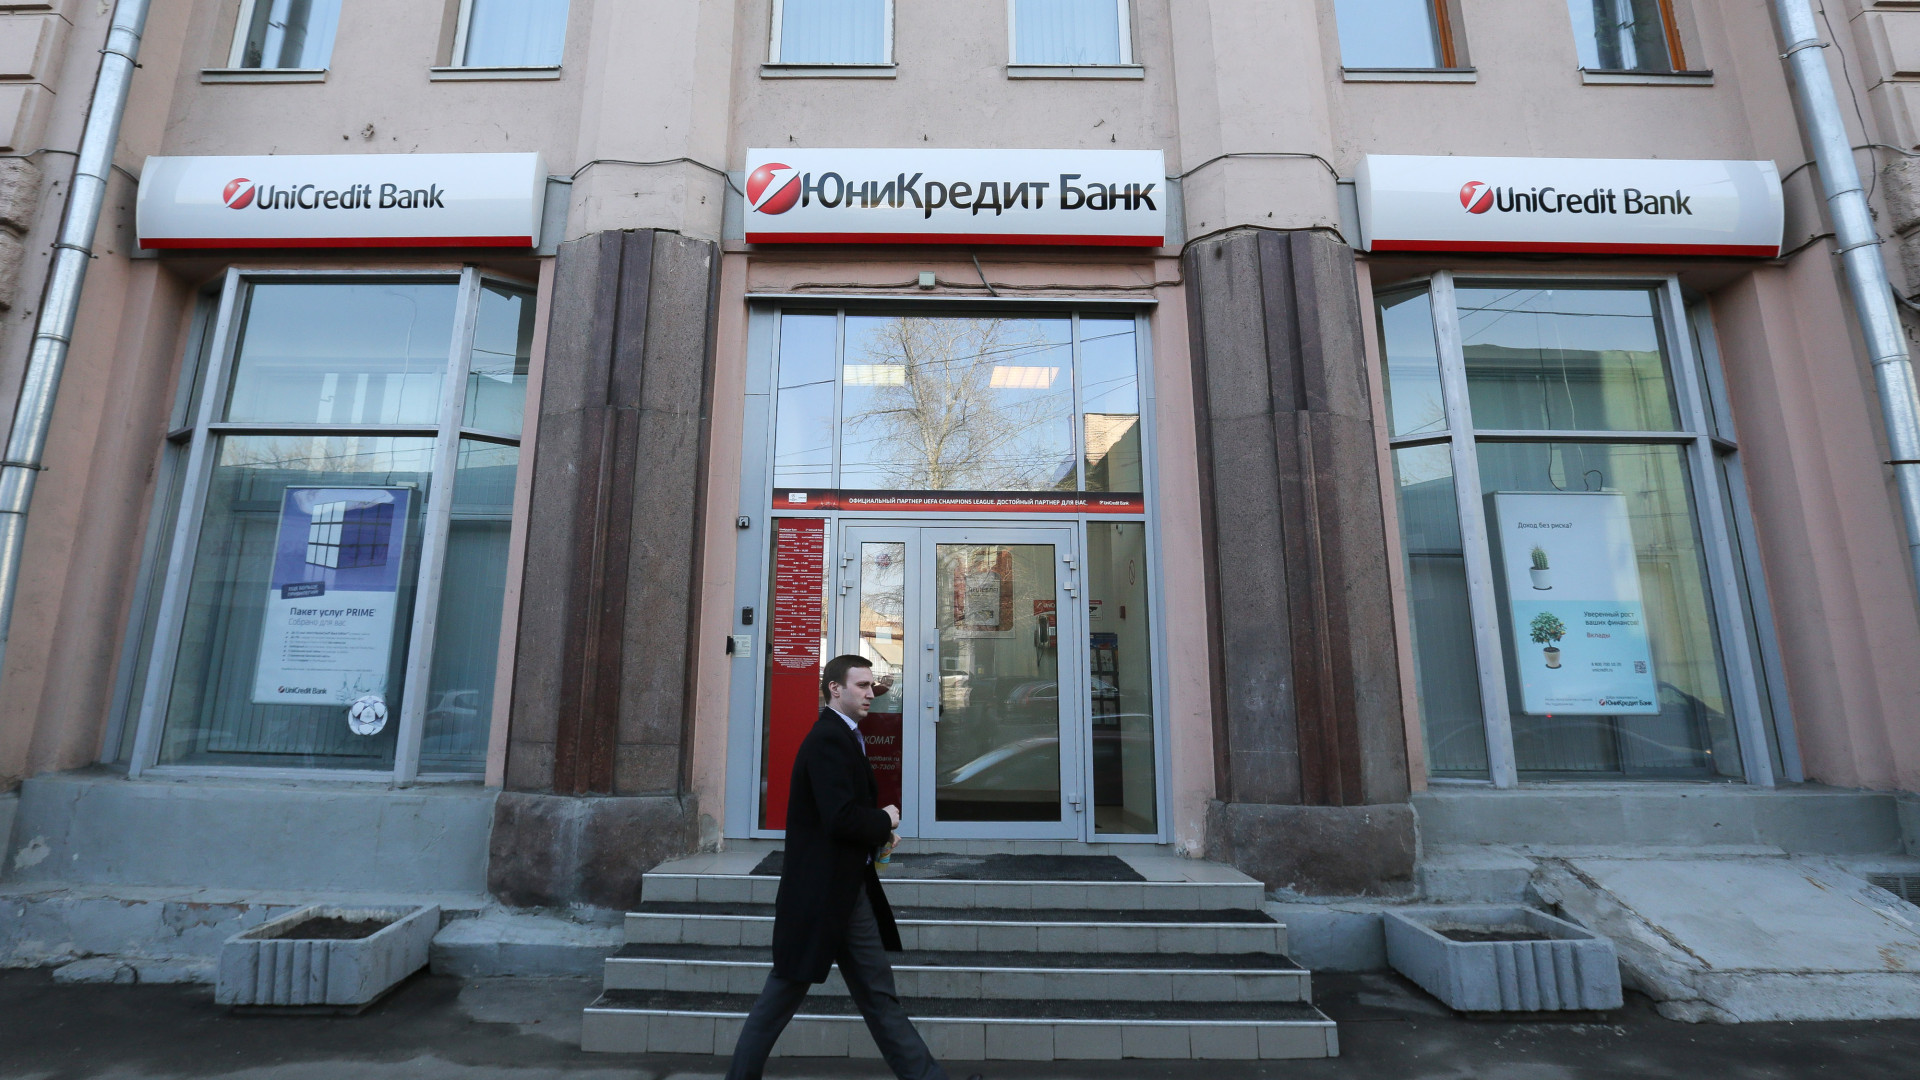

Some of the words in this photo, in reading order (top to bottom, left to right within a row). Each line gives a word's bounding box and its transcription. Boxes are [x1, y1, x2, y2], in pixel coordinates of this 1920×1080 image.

[256, 183, 372, 210] UniCredit
[378, 183, 445, 209] Bank
[801, 171, 1050, 219] ЮниКредит
[1059, 173, 1157, 211] Банк
[1495, 186, 1617, 214] UniCredit
[1623, 188, 1693, 215] Bank
[848, 497, 896, 505] ОФИЦИАЛЬНЫЙ
[996, 498, 1034, 506] ДОСТОЙНЫЙ
[1517, 521, 1538, 529] Доход
[1538, 521, 1550, 529] без
[1550, 522, 1573, 530] риска?
[290, 607, 317, 616] Пакет
[319, 609, 344, 618] услуг
[346, 608, 375, 617] PRIME
[288, 618, 317, 627] Собрано
[318, 619, 333, 627] для
[1586, 631, 1611, 639] Вклады
[285, 686, 312, 694] UniCredit
[312, 687, 327, 695] Bank
[1605, 699, 1639, 707] ЮниКредит
[863, 735, 896, 745] КОМАТ
